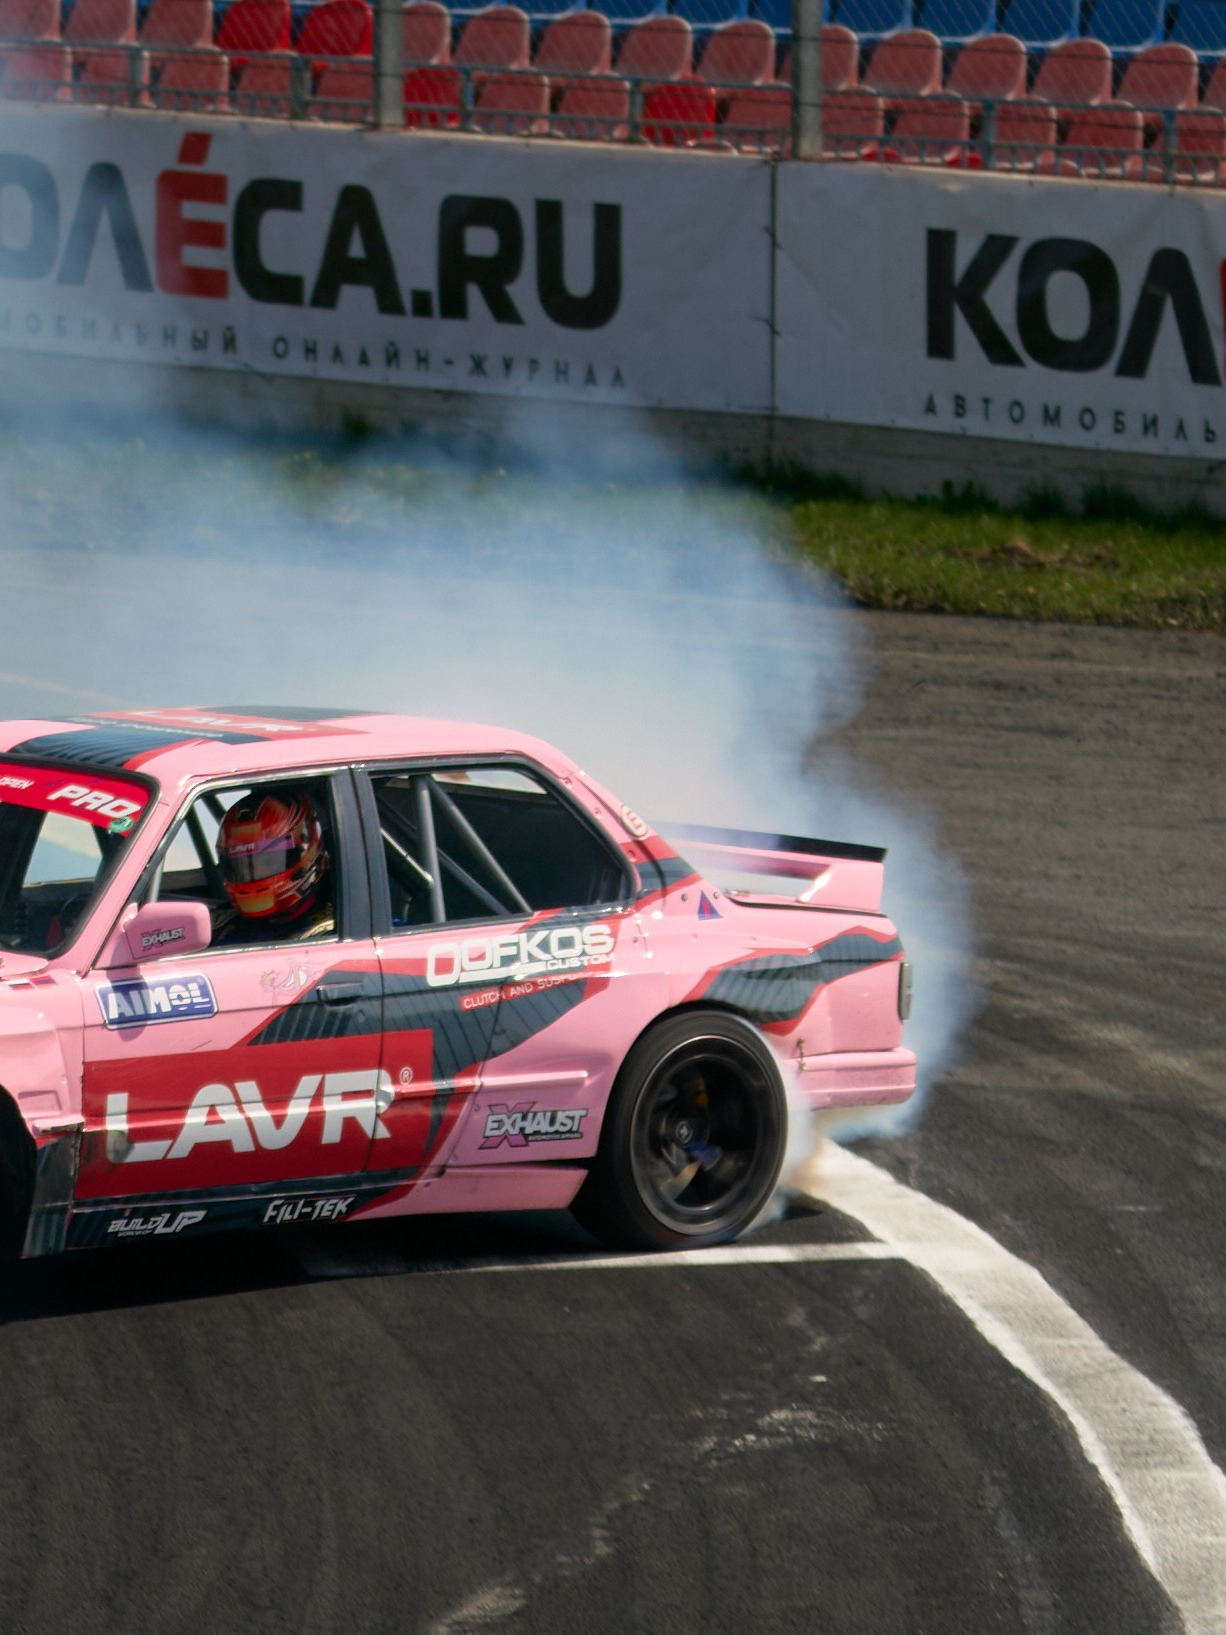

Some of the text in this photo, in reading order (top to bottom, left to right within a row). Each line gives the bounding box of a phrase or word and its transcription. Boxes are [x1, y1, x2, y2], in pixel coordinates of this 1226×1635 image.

[926, 227, 1226, 387] КОЛ
[272, 336, 625, 388] ОНЛАЙН-ЖУРНАЛ
[46, 784, 142, 818] PRO
[546, 954, 615, 971] CUSTOM
[106, 982, 211, 1020] AIMOL
[462, 981, 534, 1010] CLUTCH AND
[105, 1068, 395, 1164] LAVR
[483, 1107, 589, 1138] EXHAUST
